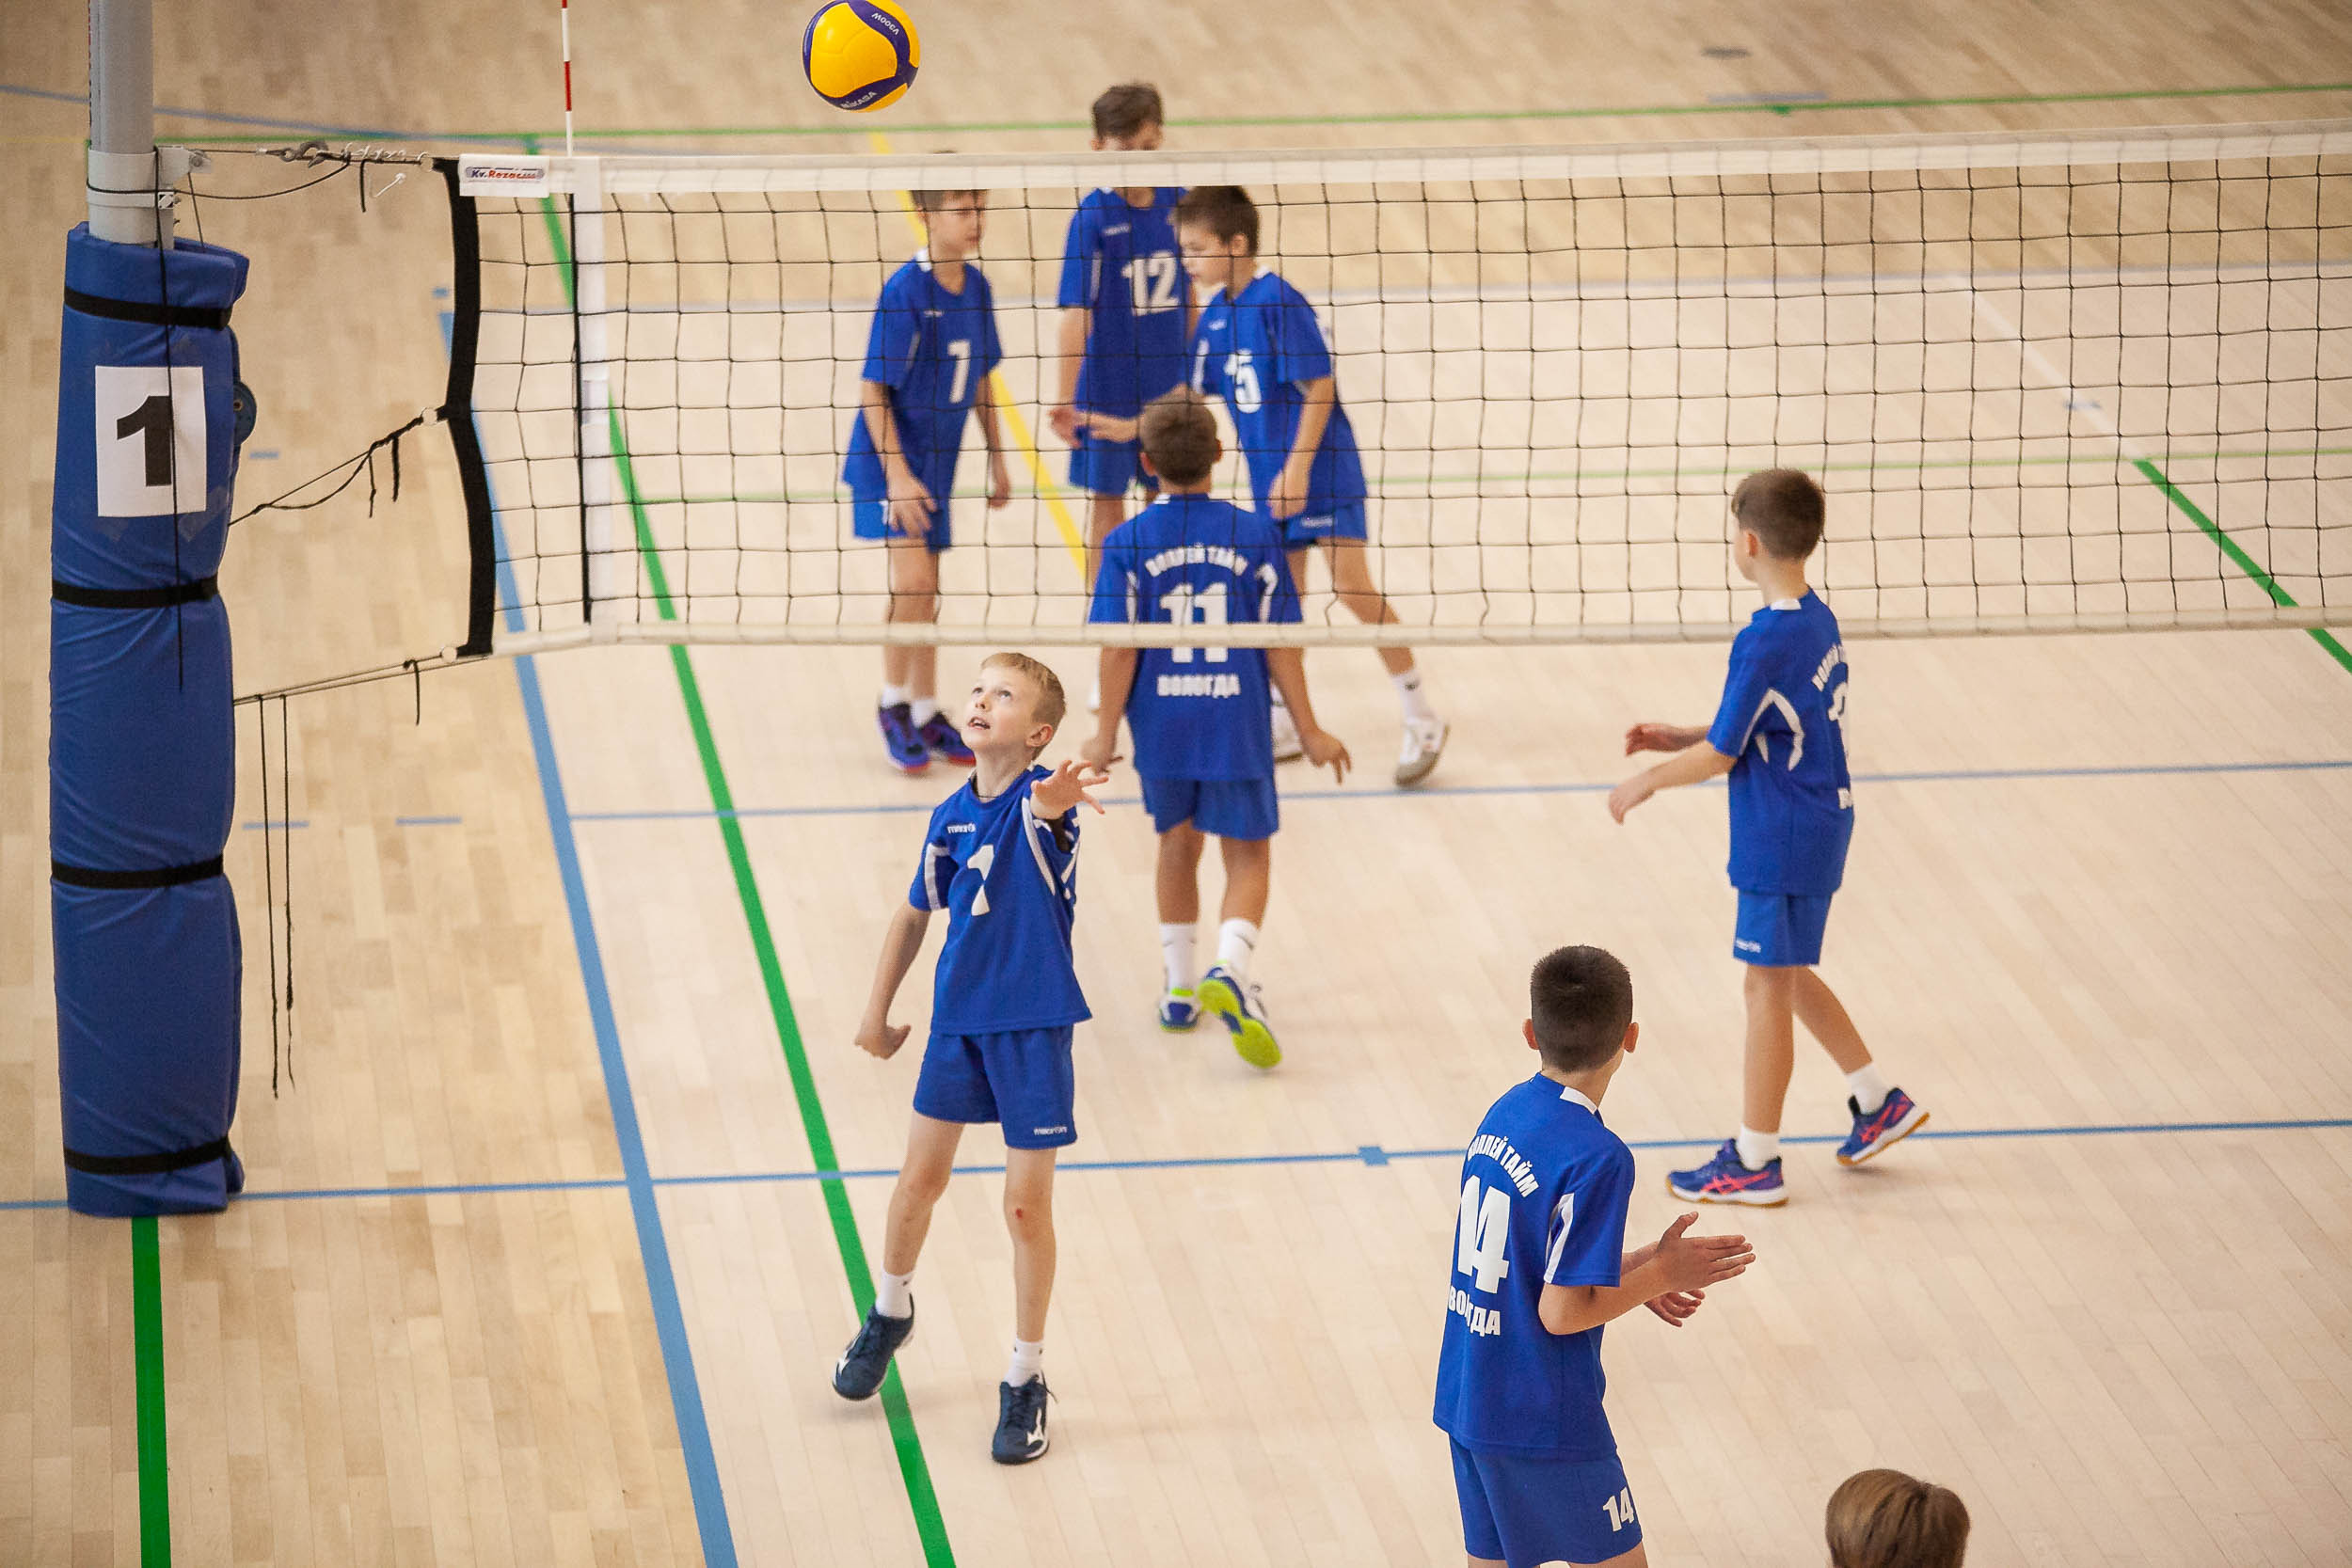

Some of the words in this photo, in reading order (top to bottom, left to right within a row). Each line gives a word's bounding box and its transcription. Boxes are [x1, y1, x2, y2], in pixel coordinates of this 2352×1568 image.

[1121, 249, 1181, 316] 12
[947, 341, 971, 404] 7
[117, 395, 173, 487] 1
[1159, 582, 1229, 663] 11
[1500, 1145, 1539, 1197] ТАЙМ
[1457, 1174, 1511, 1294] 14
[1602, 1487, 1635, 1532] 14
